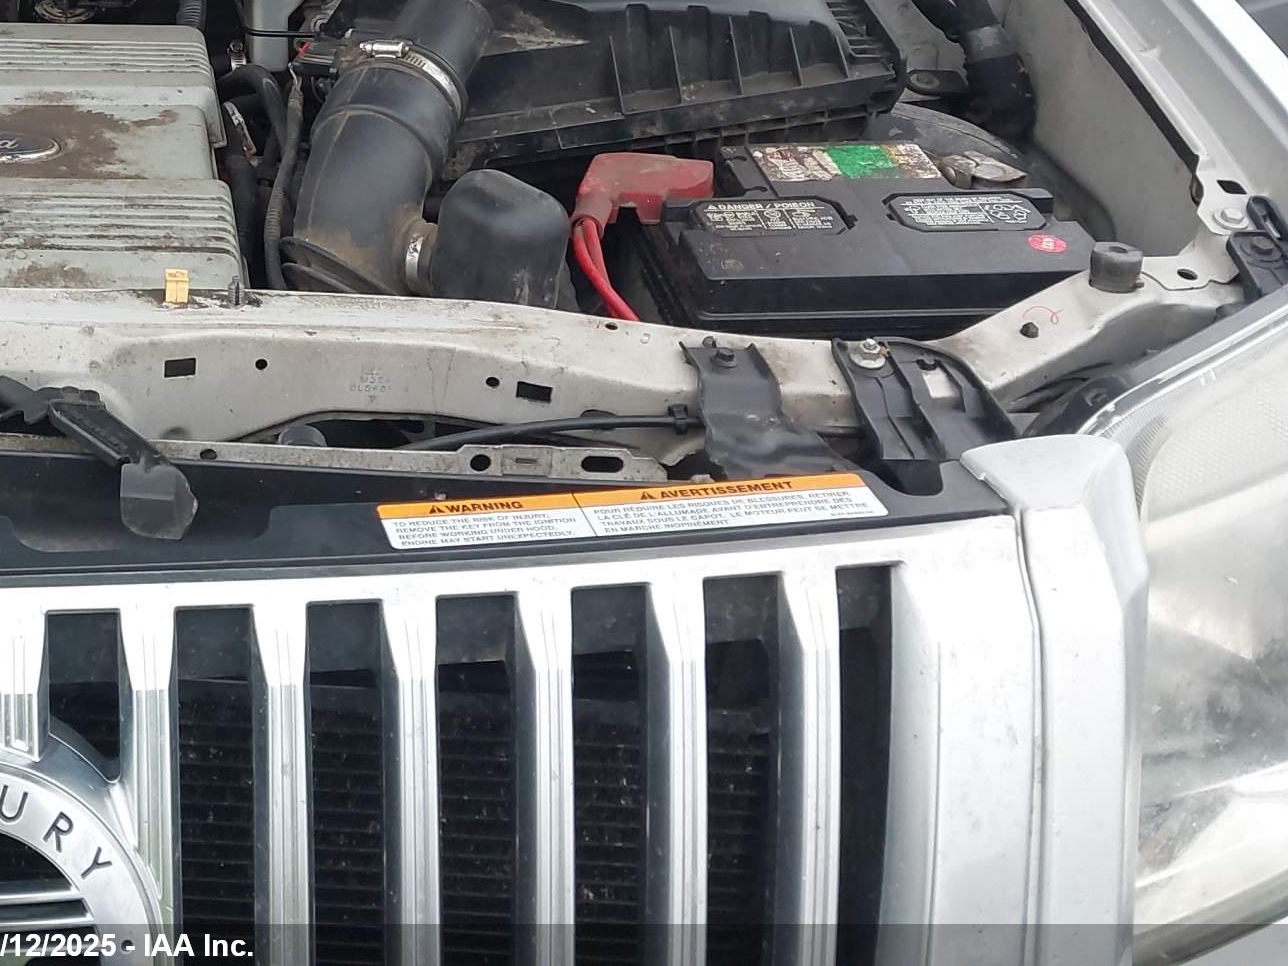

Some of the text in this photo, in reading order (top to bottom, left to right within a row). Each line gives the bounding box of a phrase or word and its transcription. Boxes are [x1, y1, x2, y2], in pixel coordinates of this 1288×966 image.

[717, 203, 763, 211] DANGER
[774, 201, 815, 209] POISON
[660, 481, 794, 500] AVERTISSEMENT
[445, 501, 523, 513] WARNING
